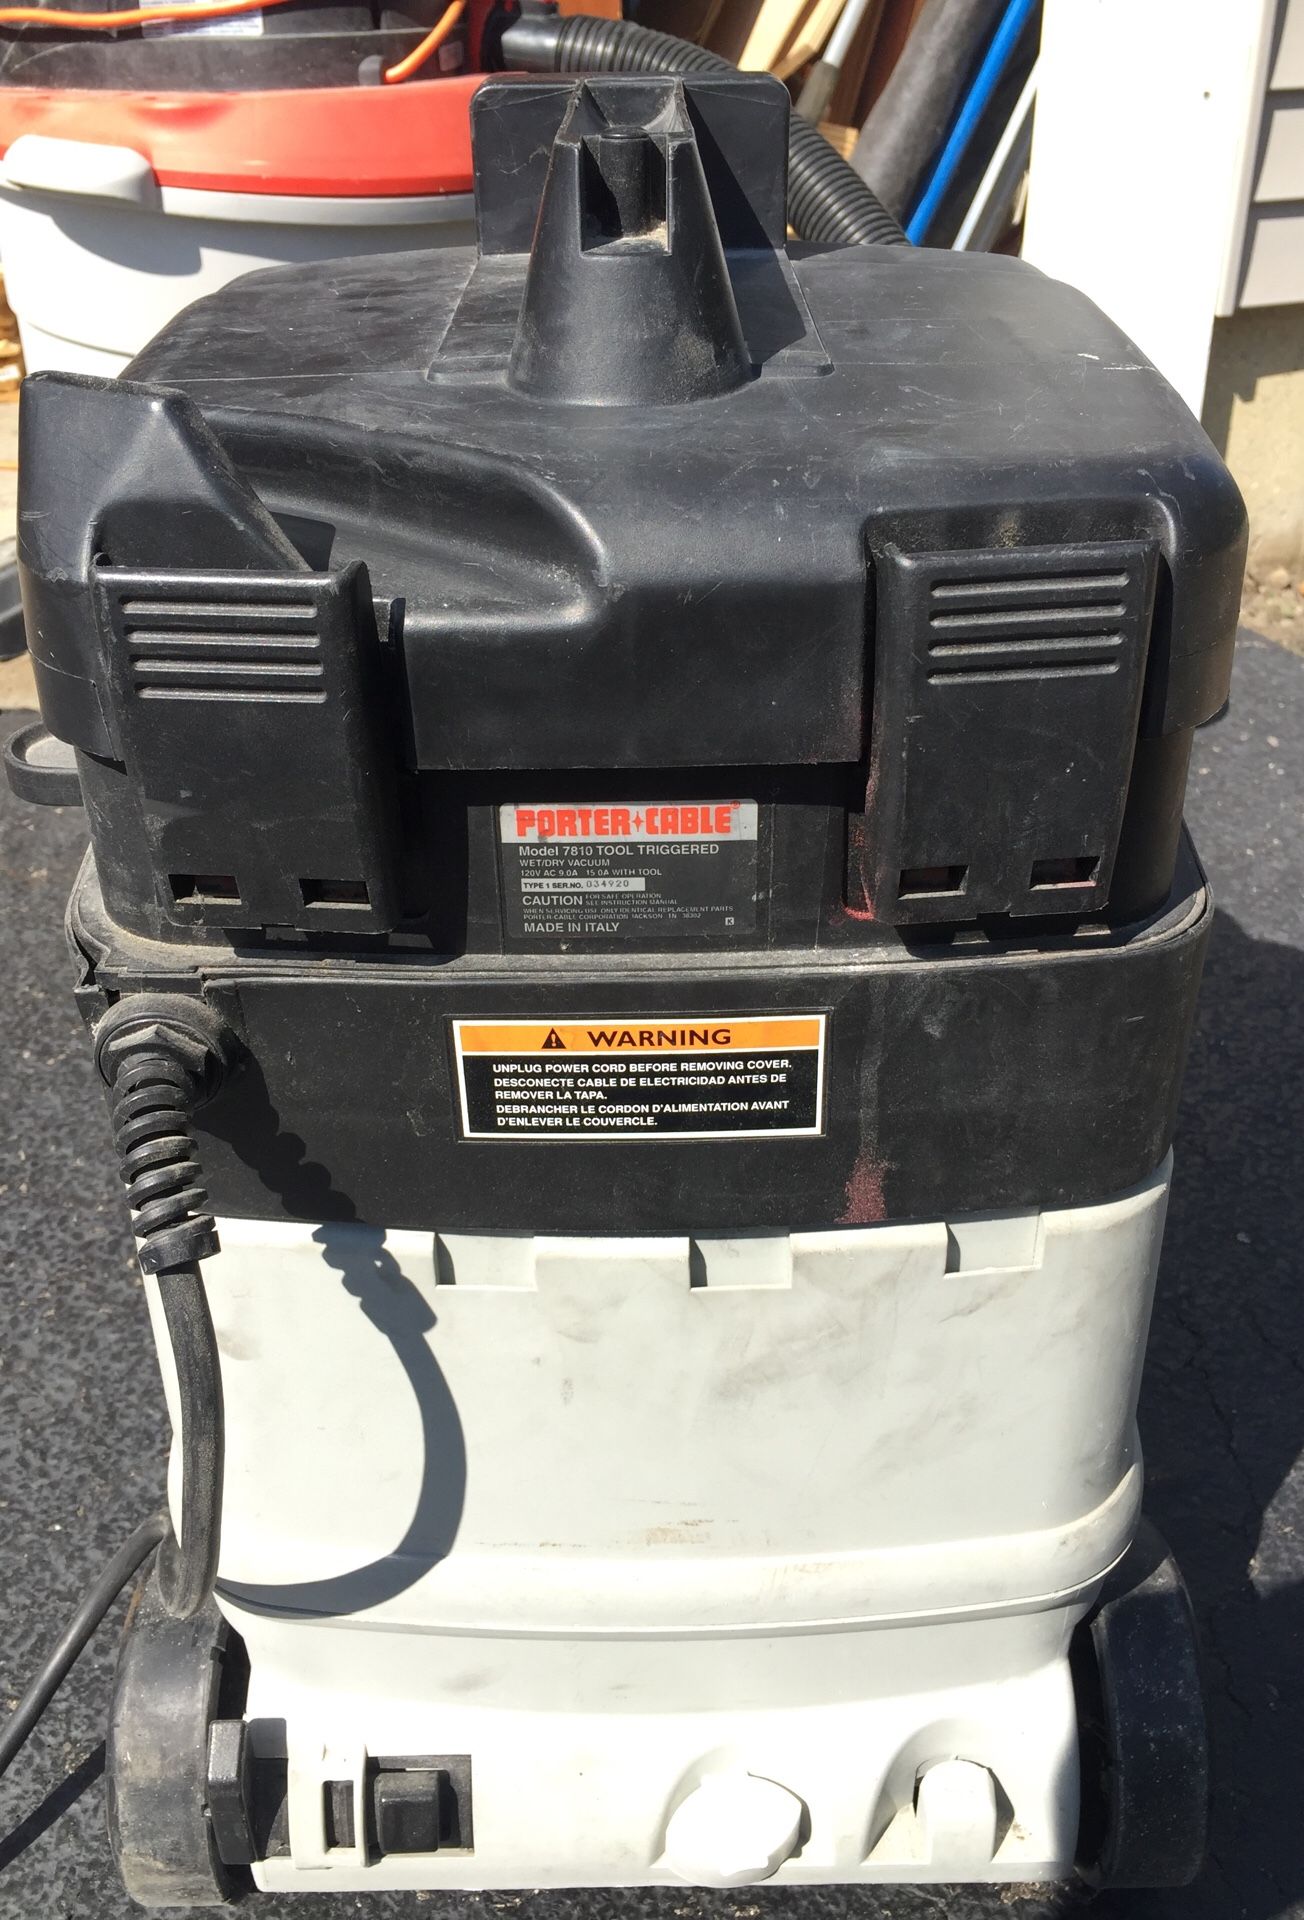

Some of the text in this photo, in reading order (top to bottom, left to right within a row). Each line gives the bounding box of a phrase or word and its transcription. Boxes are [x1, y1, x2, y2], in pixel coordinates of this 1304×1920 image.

[519, 844, 719, 856] Model 7810 TOOL TRIGGERED
[520, 859, 565, 867] WET/DRY
[639, 868, 662, 876] TOOL
[586, 880, 629, 888] 034920
[522, 895, 582, 905] CAUTION
[524, 922, 620, 932] MADE IN ITALY
[587, 1029, 731, 1047] WARNING
[493, 1059, 792, 1074] UNPLUG POWER CORD BEFORE REMOVING COVER.
[494, 1073, 786, 1088] DESCONECTE CABLE DE ELECTRICIDAD ANTES DE
[495, 1090, 607, 1100] REMOVER LA TAPA.
[496, 1100, 789, 1115] DEBRANCHER LE CORDON D'ALIMENTATION AVANT
[497, 1115, 657, 1127] D'ENLEVER LE COUVERCLE.
